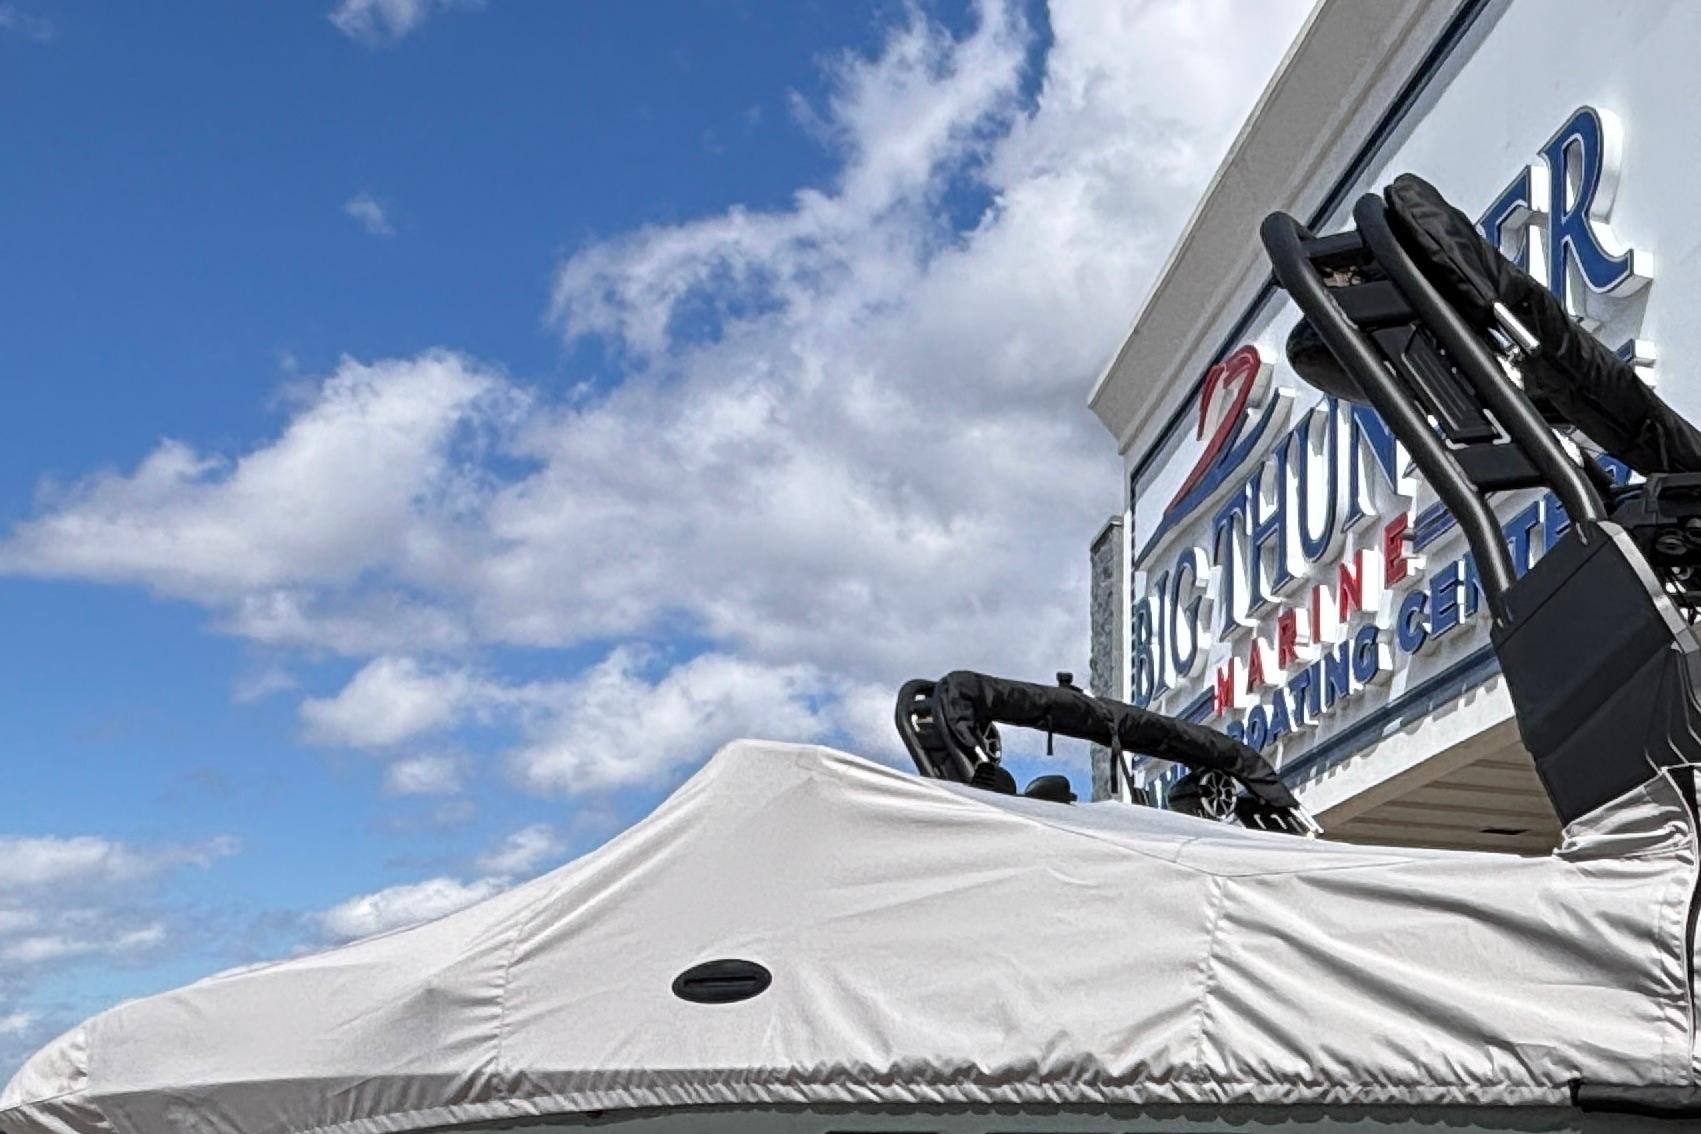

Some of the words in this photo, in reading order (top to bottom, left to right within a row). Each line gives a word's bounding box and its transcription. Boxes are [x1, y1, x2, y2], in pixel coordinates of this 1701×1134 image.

[1135, 547, 1203, 713] BIG
[1213, 105, 1634, 642] THUNR
[1215, 511, 1409, 718] MARINE
